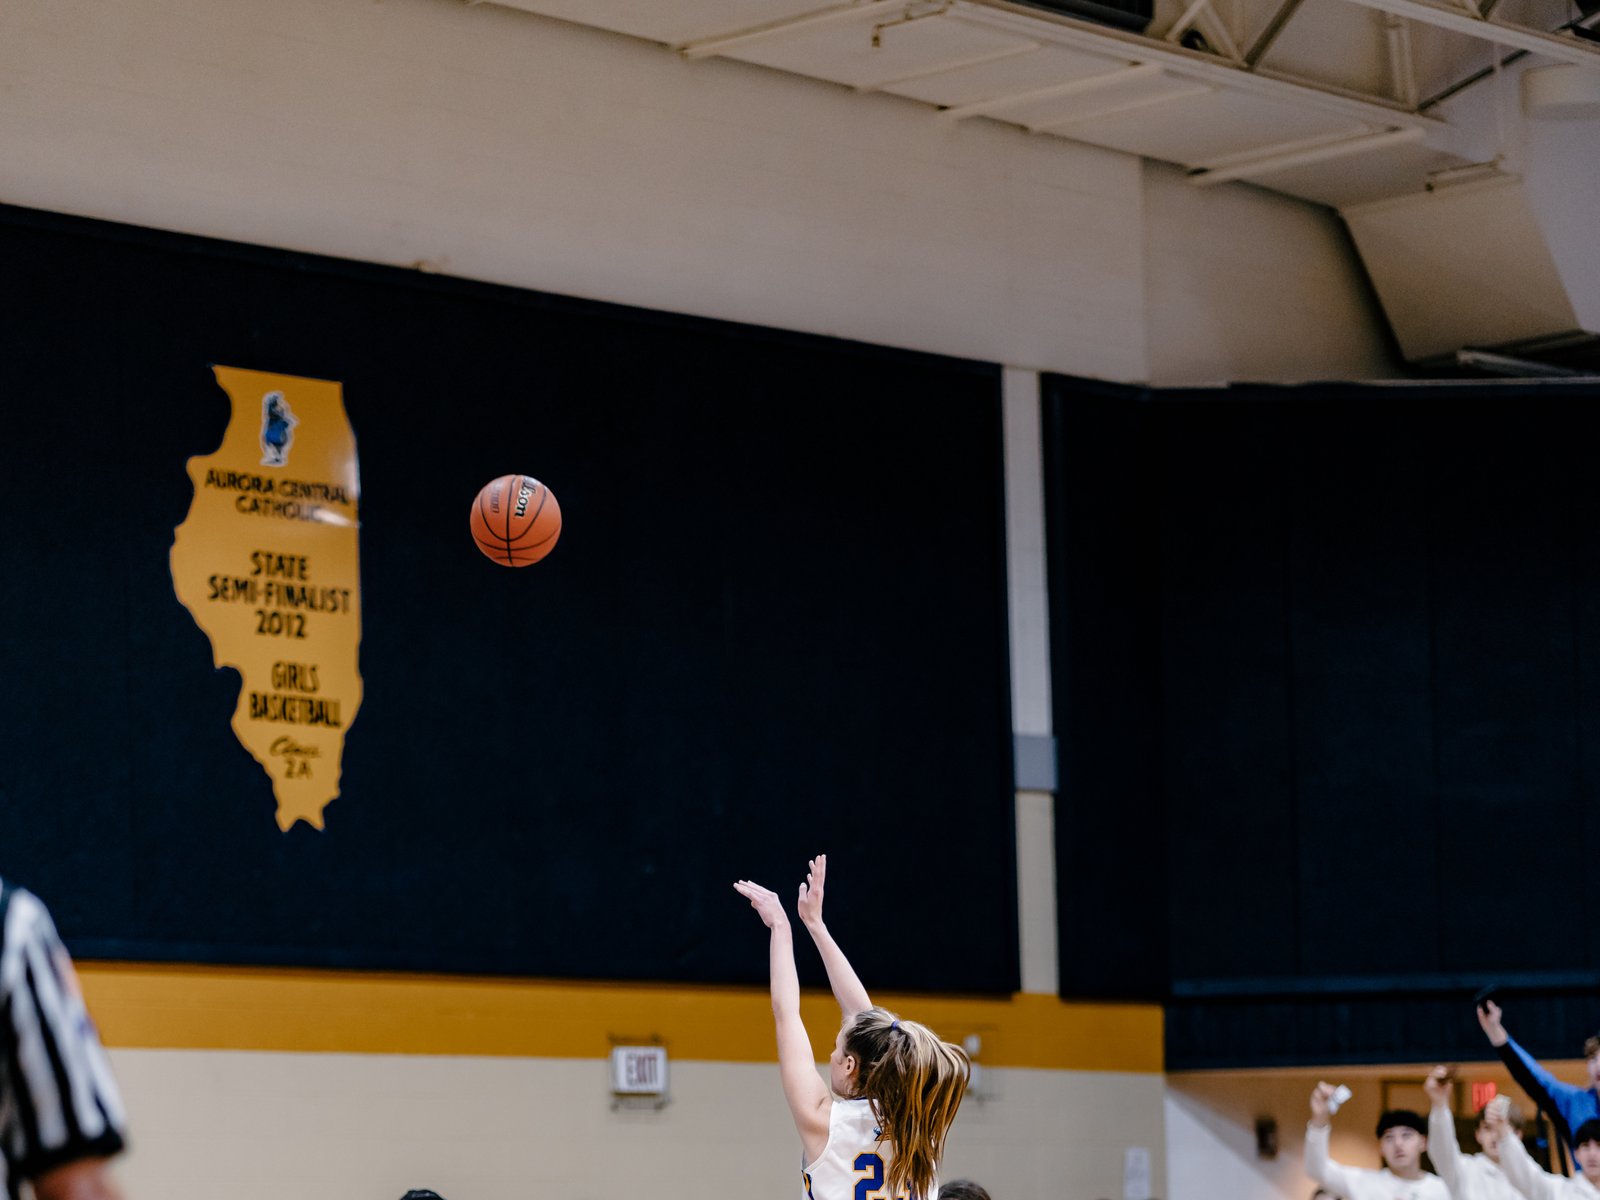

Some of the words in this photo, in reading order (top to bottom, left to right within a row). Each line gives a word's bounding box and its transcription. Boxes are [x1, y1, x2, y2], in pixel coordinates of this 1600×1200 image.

[206, 469, 274, 493] AURORA
[279, 480, 349, 504] CENTRAL
[235, 495, 323, 523] CATHOLIC
[252, 551, 308, 580] STATE
[208, 575, 350, 613] SEMI-FINALIST
[256, 610, 308, 639] 2012
[272, 662, 319, 692] GIRLS
[250, 690, 341, 728] BASKETBALL
